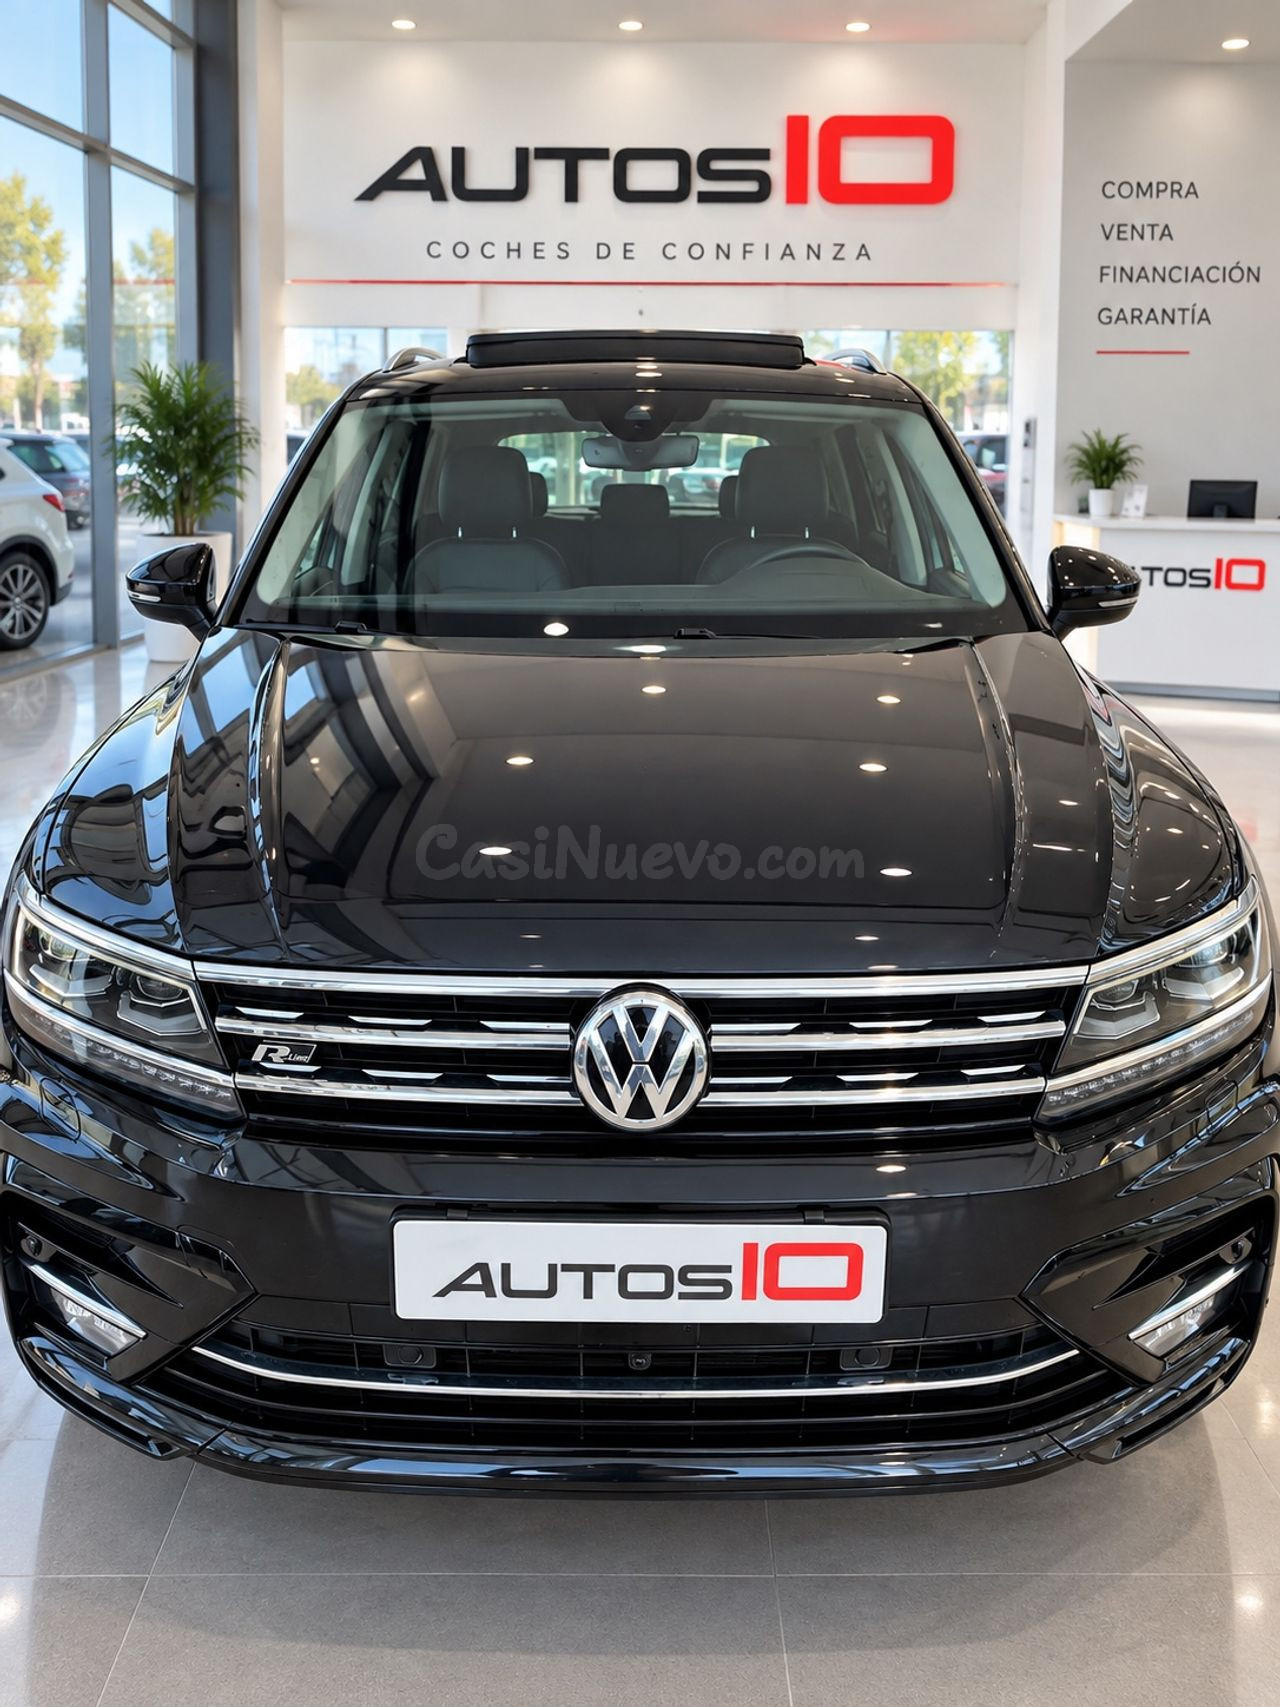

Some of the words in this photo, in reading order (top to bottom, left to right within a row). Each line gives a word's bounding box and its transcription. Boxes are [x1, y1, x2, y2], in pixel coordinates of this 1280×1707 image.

[1102, 181, 1199, 199] COMPRA
[1100, 223, 1174, 241] VENTA
[427, 241, 571, 260] COCHES
[597, 242, 636, 260] DE
[663, 242, 873, 261] CONFIANZA
[1099, 261, 1261, 283] FINANCIACIÓN
[1097, 303, 1212, 325] GARANTÍA
[1131, 557, 1266, 591] TOS10
